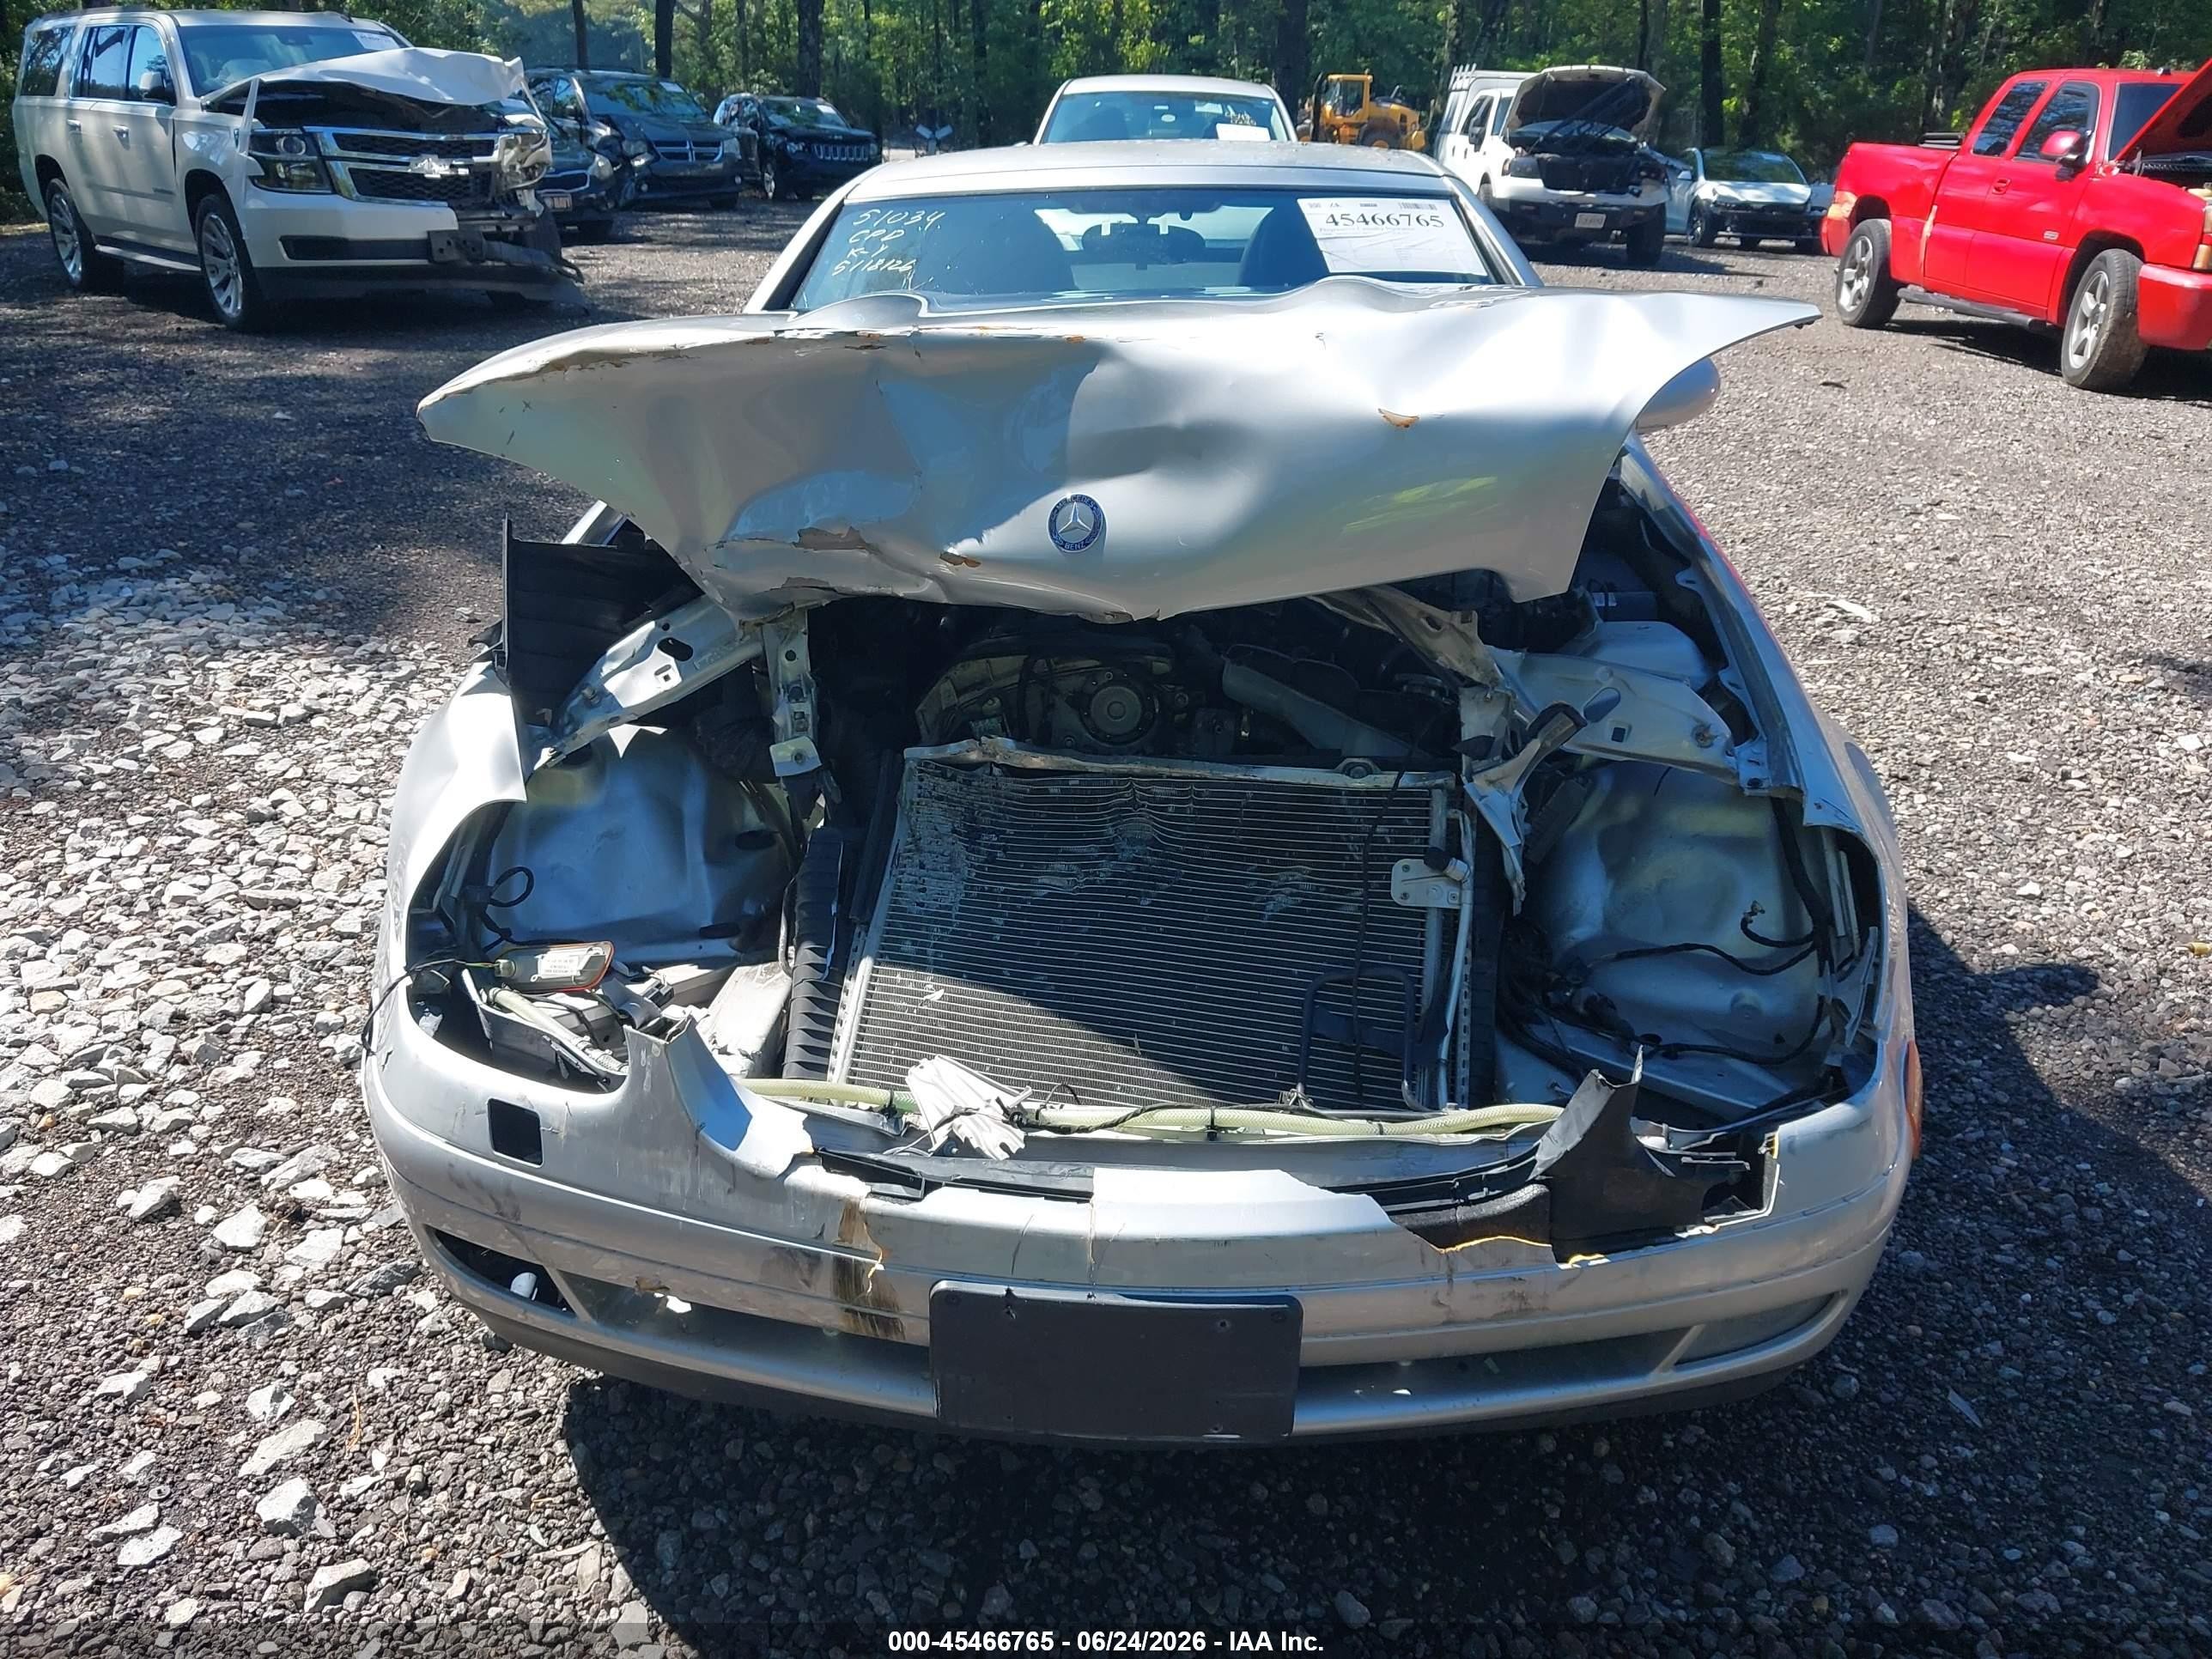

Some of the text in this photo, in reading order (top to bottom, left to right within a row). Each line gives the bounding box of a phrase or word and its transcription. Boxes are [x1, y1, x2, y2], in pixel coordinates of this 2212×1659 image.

[853, 209, 945, 231] 51034
[1326, 212, 1444, 228] 45466765
[1064, 541, 1086, 550] BENZ
